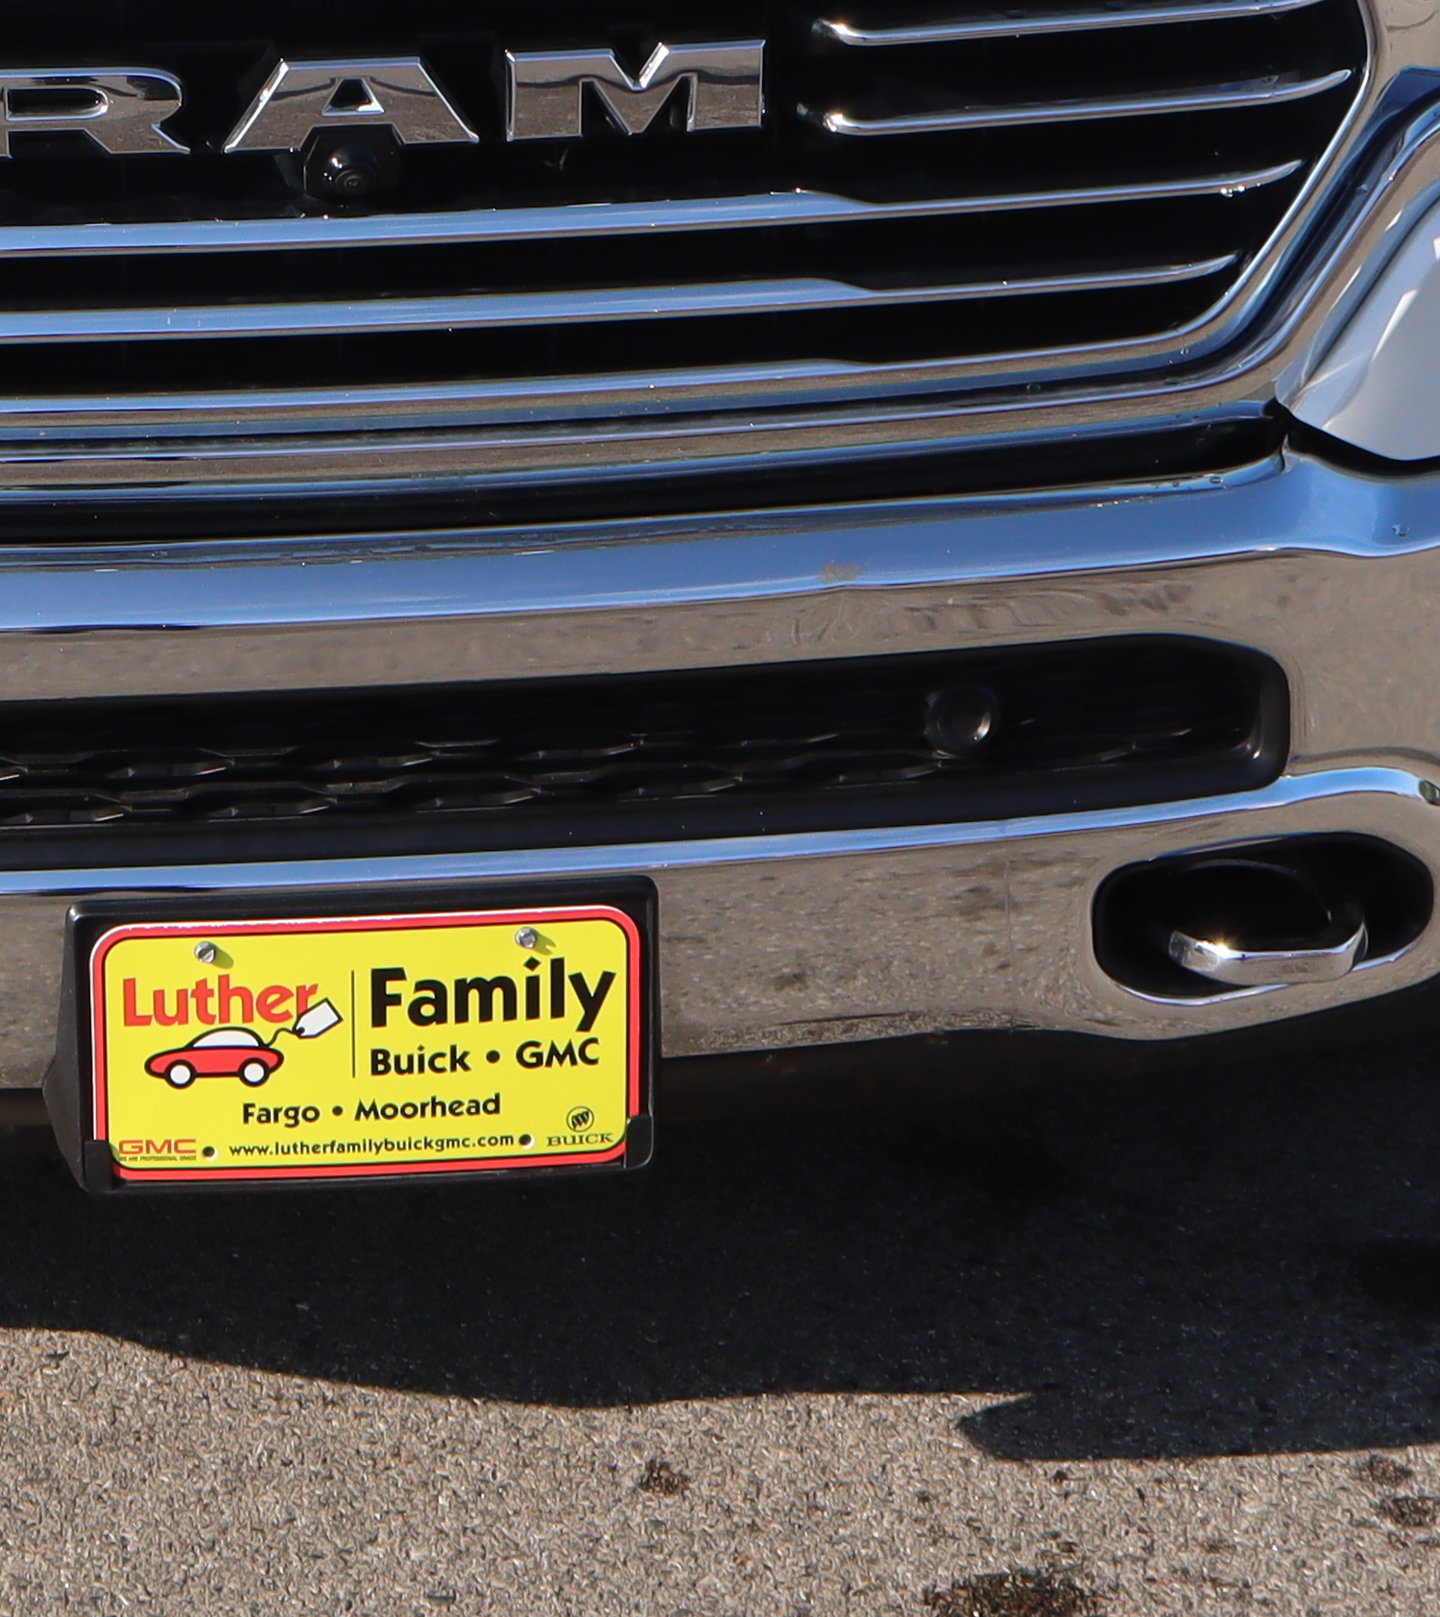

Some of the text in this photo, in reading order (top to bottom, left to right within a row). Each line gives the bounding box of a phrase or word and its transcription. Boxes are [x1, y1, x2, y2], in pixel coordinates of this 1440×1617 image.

[123, 956, 616, 1033] Luther Family
[370, 1037, 600, 1076] Buick GMC
[242, 1093, 502, 1128] Fargo Moorhead
[119, 1139, 197, 1155] GMC
[229, 1133, 515, 1157] www.lutherfamilybuickgmc.com
[546, 1132, 614, 1147] BUICK
